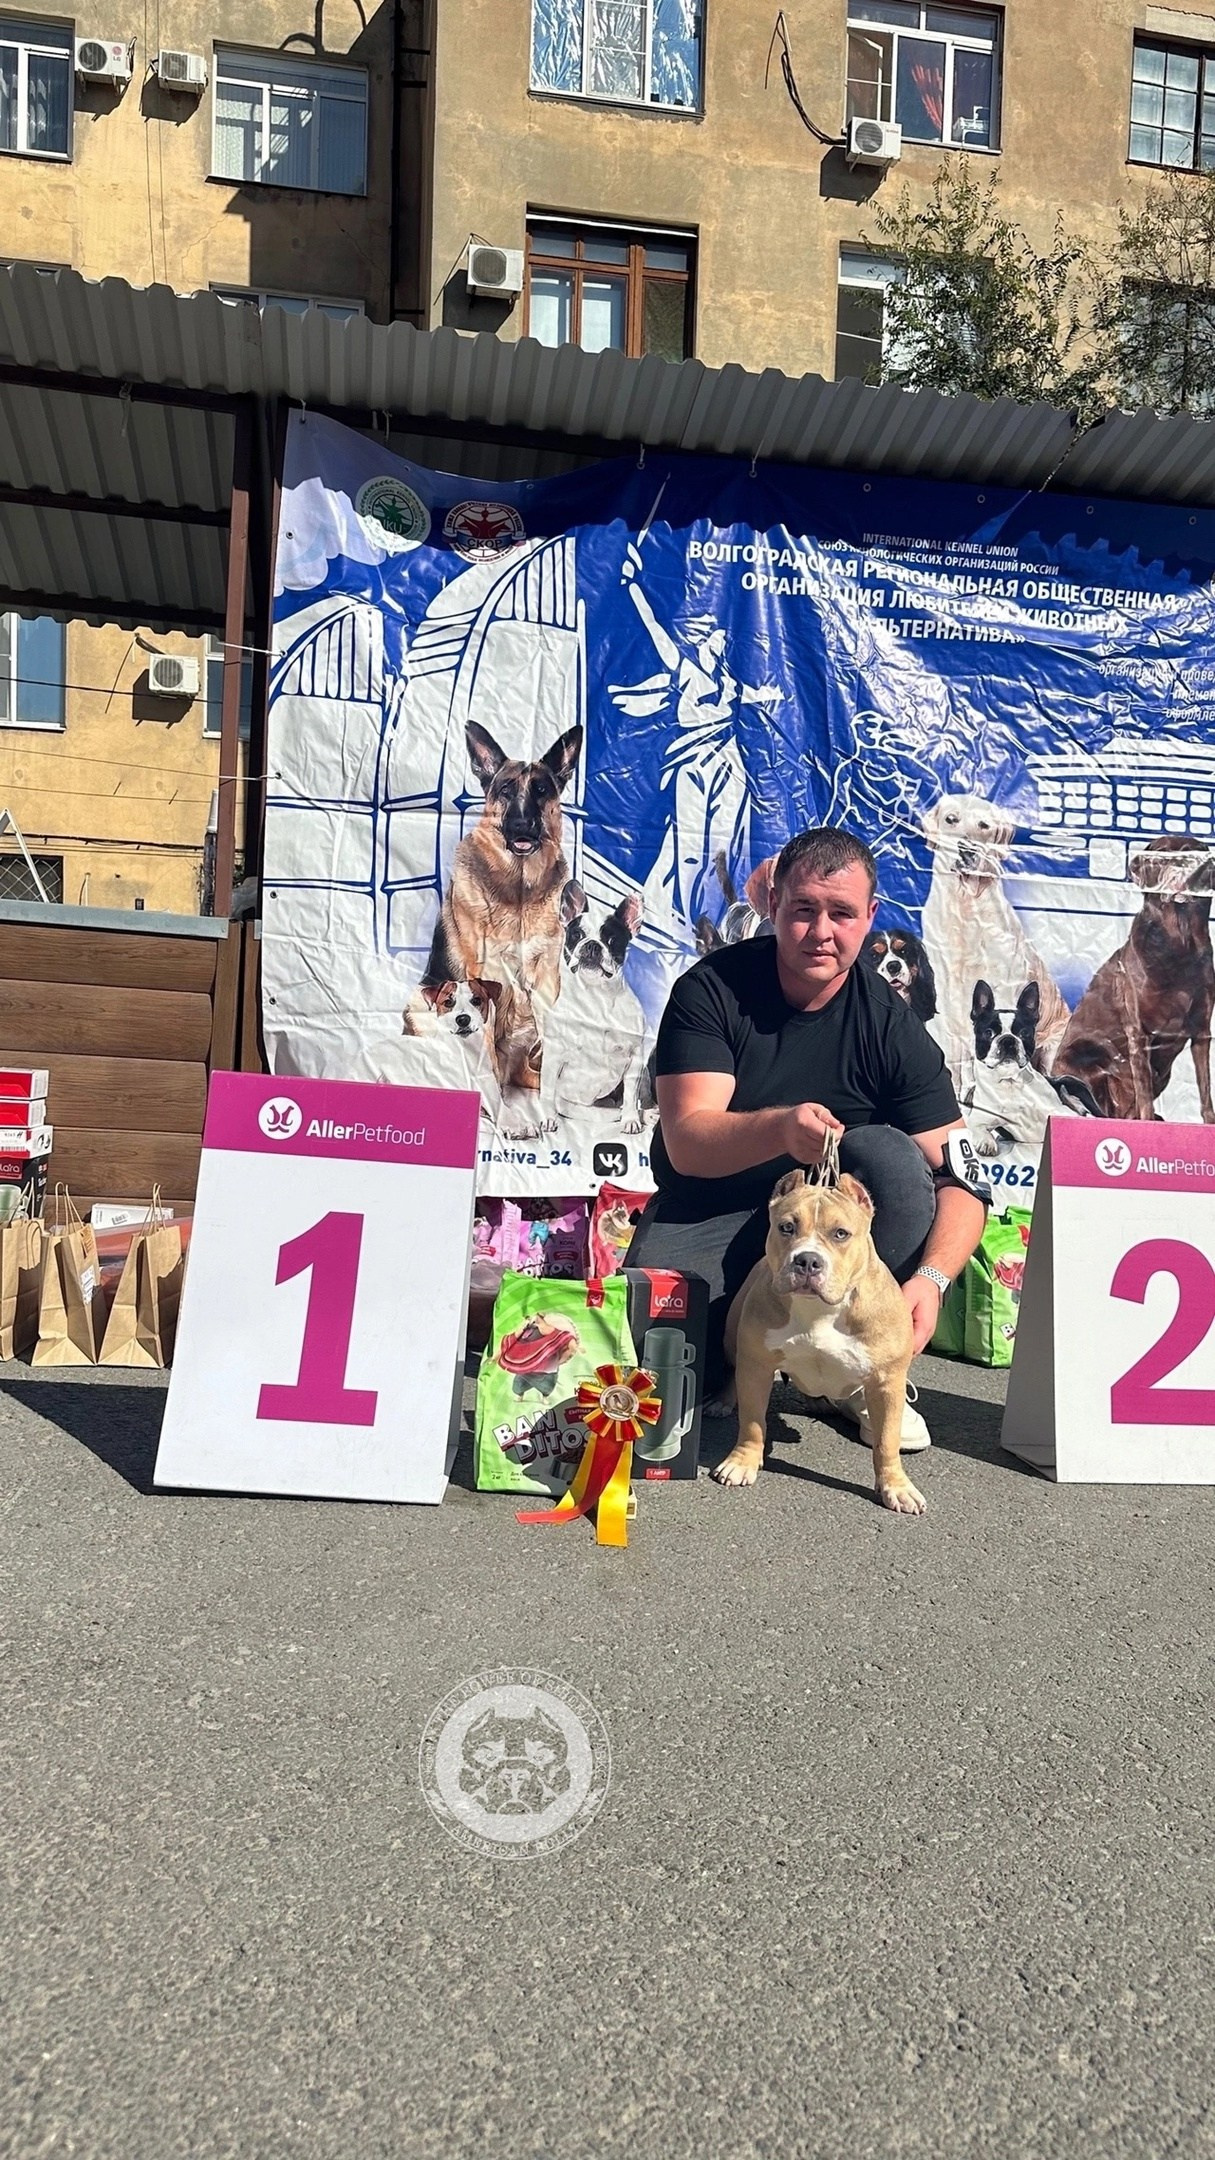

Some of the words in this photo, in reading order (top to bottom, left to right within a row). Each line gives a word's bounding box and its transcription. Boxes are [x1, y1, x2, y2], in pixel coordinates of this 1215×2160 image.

[818, 539, 848, 552] СОЮЗ
[944, 555, 1018, 573] ОРГАНИЗАЦИЙ
[1020, 562, 1059, 576] РОССИИ
[862, 532, 943, 551] INTERNATIONAL
[944, 541, 983, 555] KENNEL
[986, 545, 1019, 558] UNION
[689, 540, 858, 577] ВОЛГОГРАДСКАЯ
[862, 560, 1018, 597] РЕГИОНАЛЬНАЯ
[1022, 580, 1175, 610] ОБЩЕСТВЕННАЯ
[741, 572, 884, 608] ОРГАНИЗАЦИЯ
[862, 617, 1026, 644] ЛЬТЕРНАТИВА»
[306, 1118, 426, 1147] AllerPetfood
[478, 1148, 572, 1169] nativa_34
[1136, 1157, 1215, 1177] AllerPetfo
[256, 1211, 378, 1427] 1
[1109, 1238, 1215, 1424] 2
[492, 1409, 558, 1451] BAN
